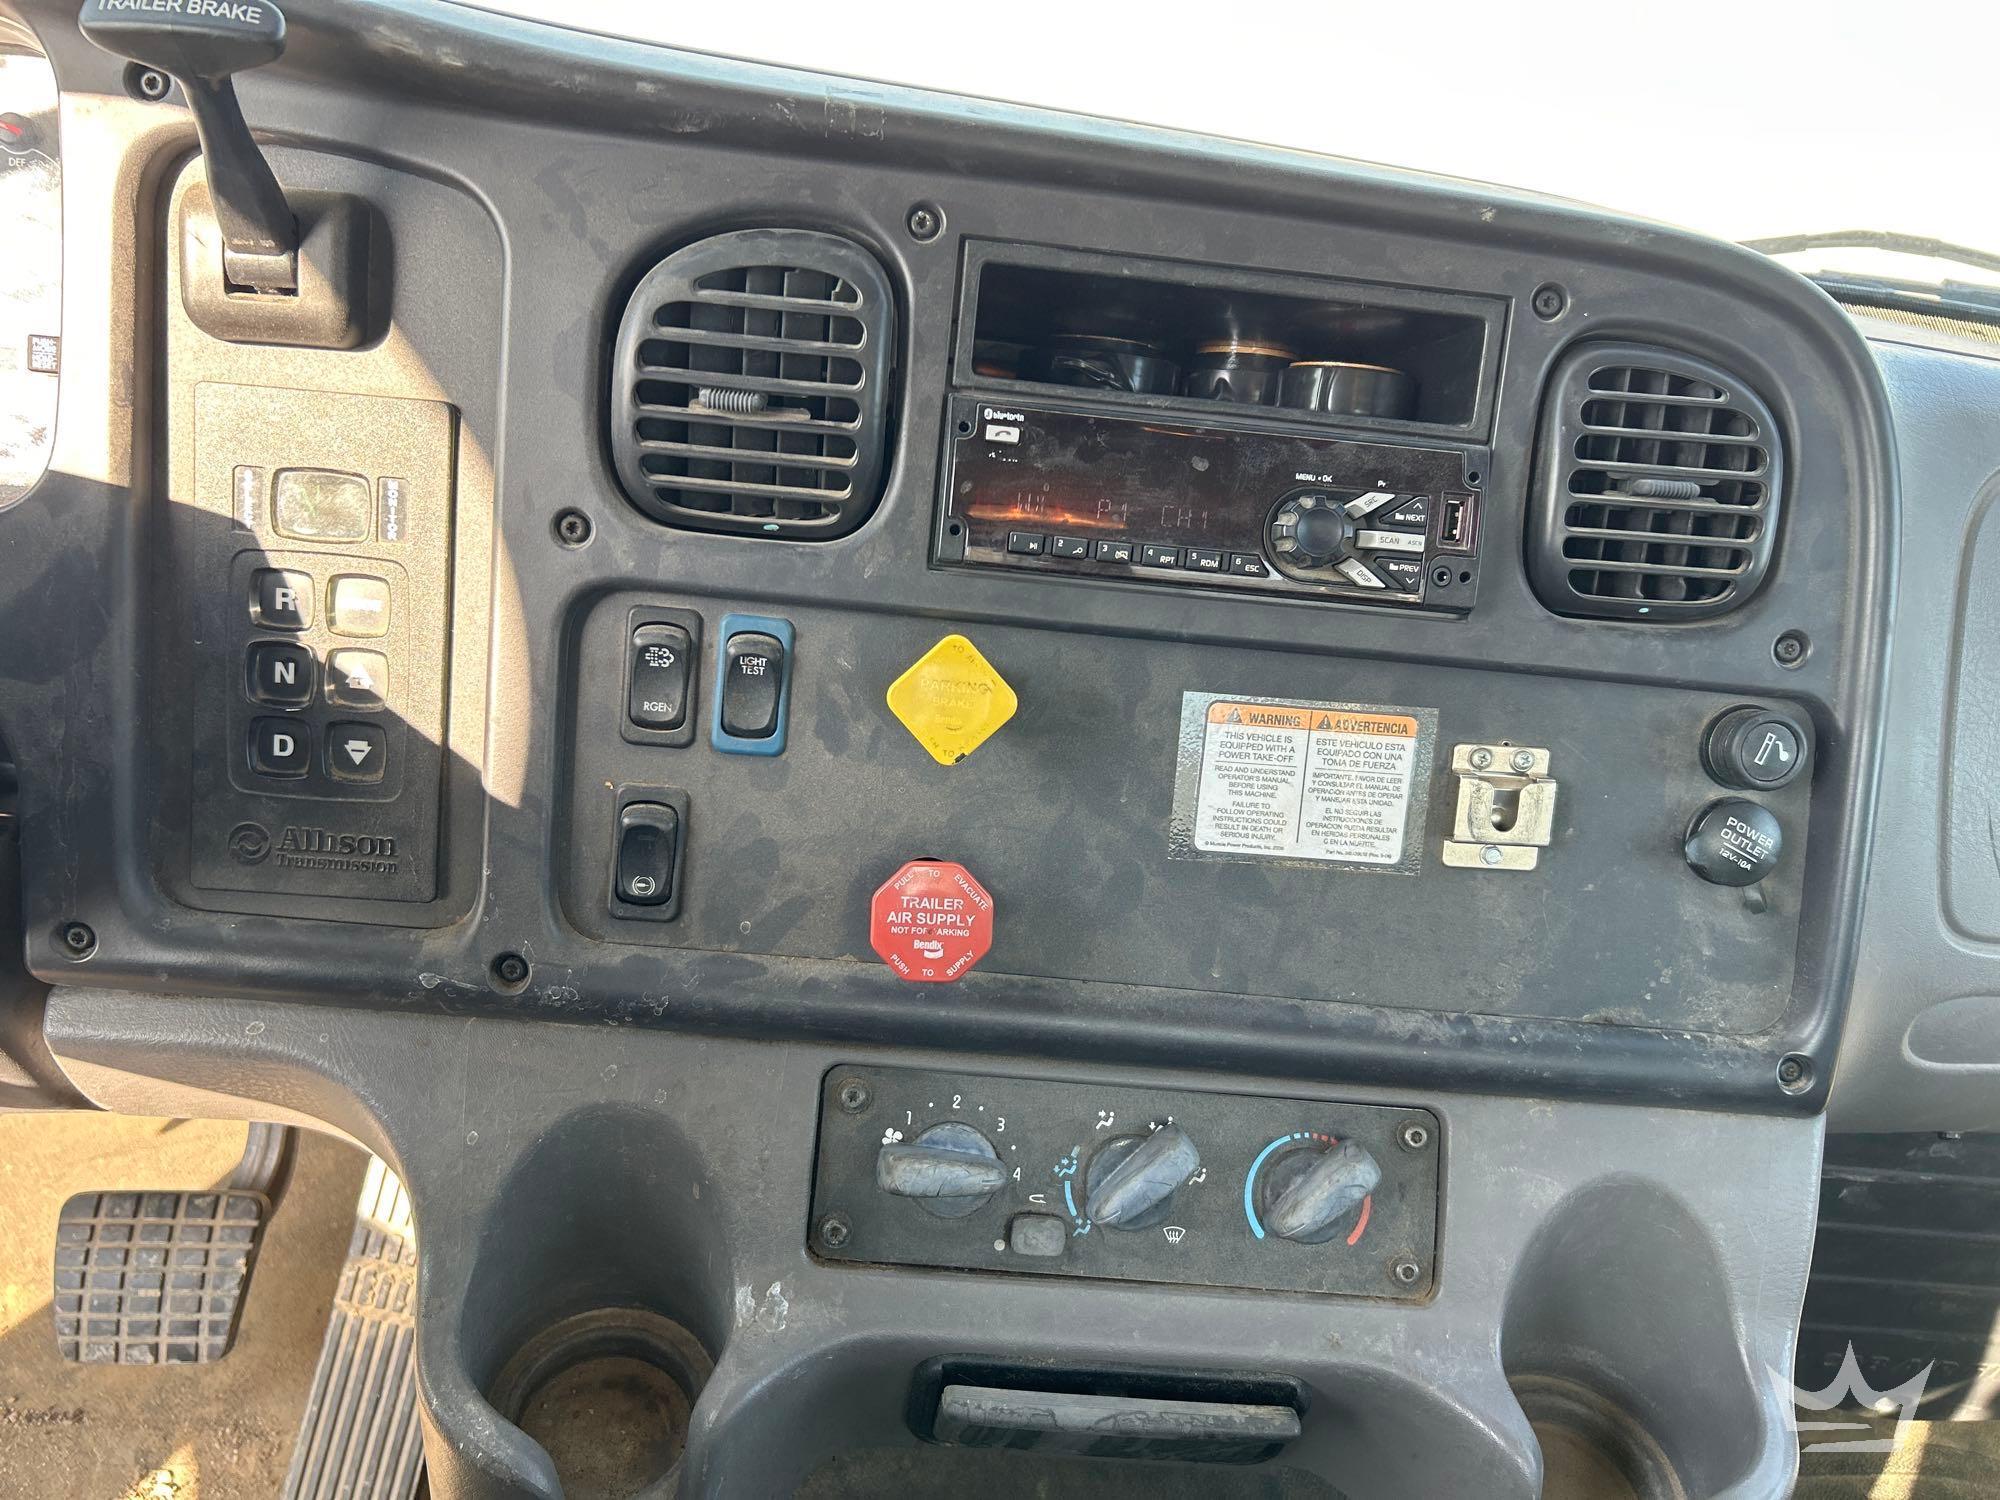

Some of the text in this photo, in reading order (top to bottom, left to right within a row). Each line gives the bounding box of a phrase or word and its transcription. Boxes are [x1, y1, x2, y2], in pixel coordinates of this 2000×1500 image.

[187, 0, 263, 24] BRAKE
[1295, 473, 1316, 481] MENU
[1364, 496, 1378, 508] SRC
[1405, 513, 1426, 521] NEXT
[1058, 539, 1064, 547] 2
[1379, 537, 1400, 545] SCAN
[1160, 555, 1175, 564] RPT
[1200, 559, 1219, 568] RDM
[1245, 564, 1259, 573] ESC
[1356, 569, 1371, 583] DISP
[275, 587, 297, 610] R
[739, 656, 768, 667] LIGHT
[274, 661, 295, 685] N
[741, 665, 765, 676] TEST
[643, 701, 672, 712] RGEN
[933, 696, 976, 708] BRAKE
[1248, 712, 1301, 726] WARNING
[1334, 718, 1408, 734] ADVERTENCIA
[1224, 731, 1244, 740] THIS
[1246, 732, 1282, 743] VEHICLE
[273, 734, 295, 757] D
[1219, 740, 1263, 751] EQUIPPED
[1265, 744, 1287, 752] WITH
[1316, 737, 1406, 751] ESTE VEHICULO ESTA
[943, 749, 955, 758] TO
[1218, 750, 1293, 762] POWER TAKE-OFF
[1316, 747, 1360, 758] EQUIPADO
[1321, 757, 1346, 766] TOMA
[1363, 760, 1396, 770] FUERZA
[1217, 772, 1260, 781] OPERATOR'S
[1250, 767, 1295, 776] UNDERSTAND
[1317, 780, 1354, 788] CONSULTAR
[1364, 783, 1390, 791] MANUAL
[1345, 789, 1366, 797] ANTES
[1377, 792, 1402, 800] OPERAR
[1232, 800, 1259, 808] FAILURE
[1212, 814, 1286, 826] INSTRUCTIONS COULD
[1246, 810, 1284, 818] OPERATING
[1214, 822, 1239, 830] RESULT
[1366, 826, 1397, 834] RESULTAR
[1220, 830, 1249, 838] SERIOUS
[1349, 832, 1390, 841] PERSONALES
[1726, 816, 1775, 849] POWER
[279, 826, 398, 858] Allison
[1720, 828, 1769, 861] OUTLET
[277, 852, 398, 873] Transmission
[893, 869, 988, 911] PULL TO EVACUATE
[900, 896, 964, 911] TRAILER
[886, 911, 976, 927] AIR SUPPLY
[891, 926, 909, 935] NOT
[913, 940, 943, 950] Bendix
[890, 949, 974, 977] PUSH TO SUPPLY
[952, 1094, 961, 1109] 2
[906, 1110, 912, 1125] 1
[996, 1117, 1006, 1132] 3
[1012, 1166, 1021, 1181] 4
